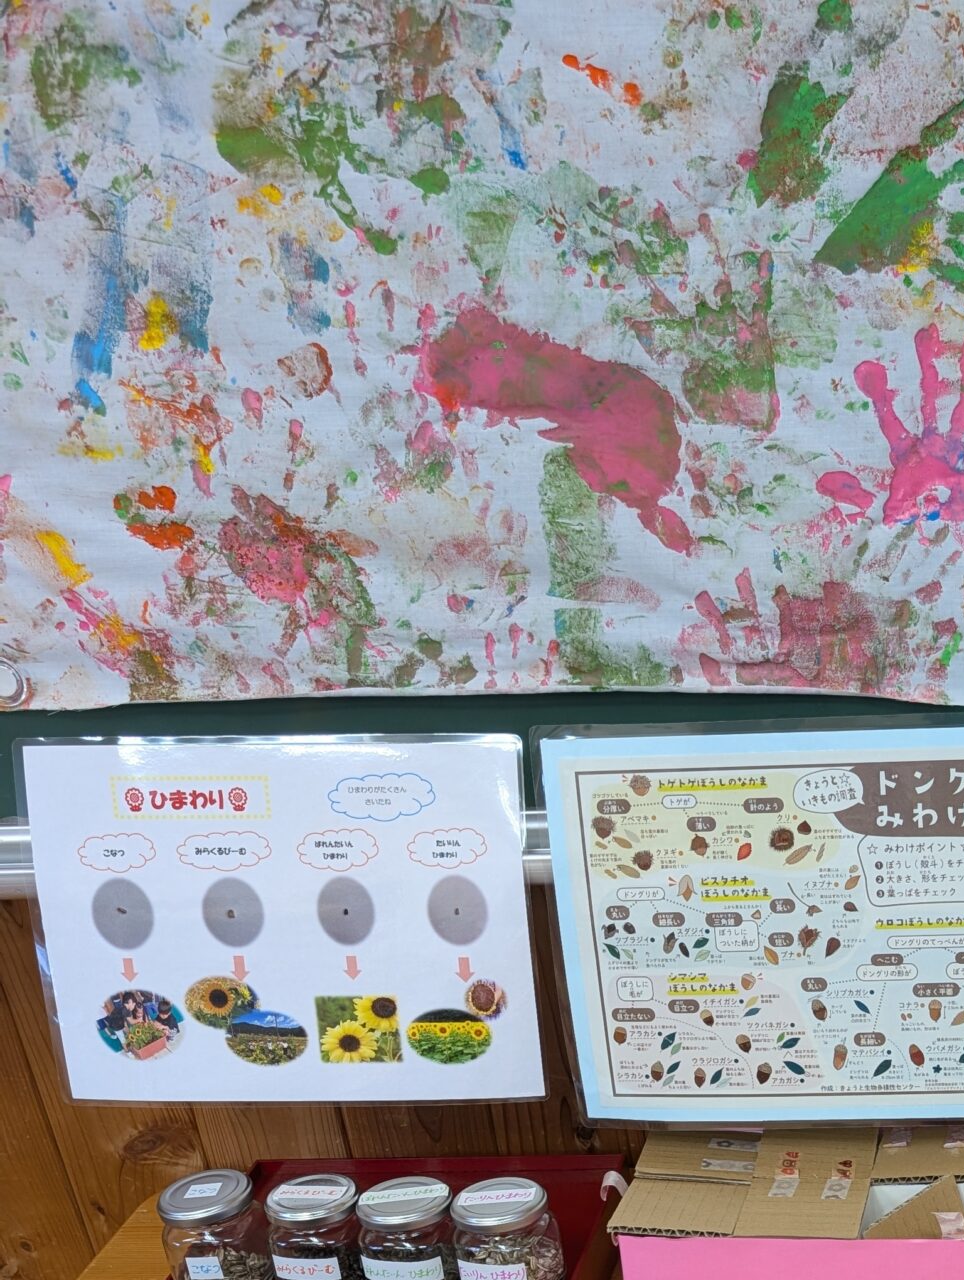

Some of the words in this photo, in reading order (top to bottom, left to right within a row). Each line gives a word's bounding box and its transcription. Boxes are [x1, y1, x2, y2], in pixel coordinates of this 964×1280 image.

[658, 776, 767, 789] トゲトゲぼうしのなかま
[804, 776, 838, 791] きょうと
[347, 785, 407, 794] ひまわりがたくさん
[149, 789, 224, 810] ひまわり
[364, 798, 392, 806] さいたね
[668, 798, 691, 806] トゲが
[802, 788, 857, 807] いきもの調査
[602, 805, 626, 814] 分厚い
[750, 803, 779, 811] 針のよう
[620, 815, 650, 824] アベマキ
[776, 813, 791, 822] クリ
[694, 821, 710, 830] 薄い
[314, 840, 354, 848] ばれんたいん
[436, 839, 461, 847] たいりん
[712, 836, 733, 844] カシワ
[194, 847, 247, 856] みらくるびーむ
[884, 842, 956, 853] みわけポイント
[103, 849, 125, 857] こなつ
[322, 852, 348, 860] ひまわり
[432, 851, 458, 859] ひまわり
[656, 848, 678, 858] クヌギ
[804, 880, 833, 889] イヌブナ
[623, 890, 659, 898] ドングリが
[701, 887, 770, 899] ぼうしのなかま
[886, 888, 956, 898] 葉っぱをチェック
[775, 903, 791, 912] 長い
[611, 911, 627, 919] 丸い
[658, 917, 681, 926] 細長い
[713, 918, 735, 926] 三角錐
[677, 928, 704, 936] スダジイ
[718, 928, 748, 937] ぼうしに
[615, 935, 649, 945] ツブラジイ
[719, 938, 756, 948] ついた柄が
[774, 938, 790, 947] 短い
[781, 950, 794, 958] ブナ
[876, 956, 899, 964] へこむ
[668, 972, 707, 981] シマシマ
[861, 968, 913, 979] ドングリの形が
[669, 983, 737, 993] ぼうしのなかま
[806, 983, 822, 991] 丸い
[628, 990, 643, 998] 毛が
[826, 989, 869, 998] シリブカガシ
[702, 998, 738, 1007] イチイガシ
[673, 1004, 695, 1012] 目立つ
[616, 1012, 651, 1020] 目立たない
[746, 1022, 790, 1030] ツクバネガシ
[629, 1030, 657, 1038] アラカシ
[851, 1049, 887, 1057] マテバシイ
[926, 1044, 961, 1053] ウバメガシ
[691, 1057, 734, 1066] ウラジロガシ
[617, 1072, 644, 1081] シラカシ
[771, 1076, 800, 1085] アカガシ
[188, 1186, 218, 1196] こなつ
[279, 1188, 339, 1197] みらくるびーむ
[191, 1264, 220, 1274] こなつ
[276, 1263, 336, 1275] みらくるびーむ
